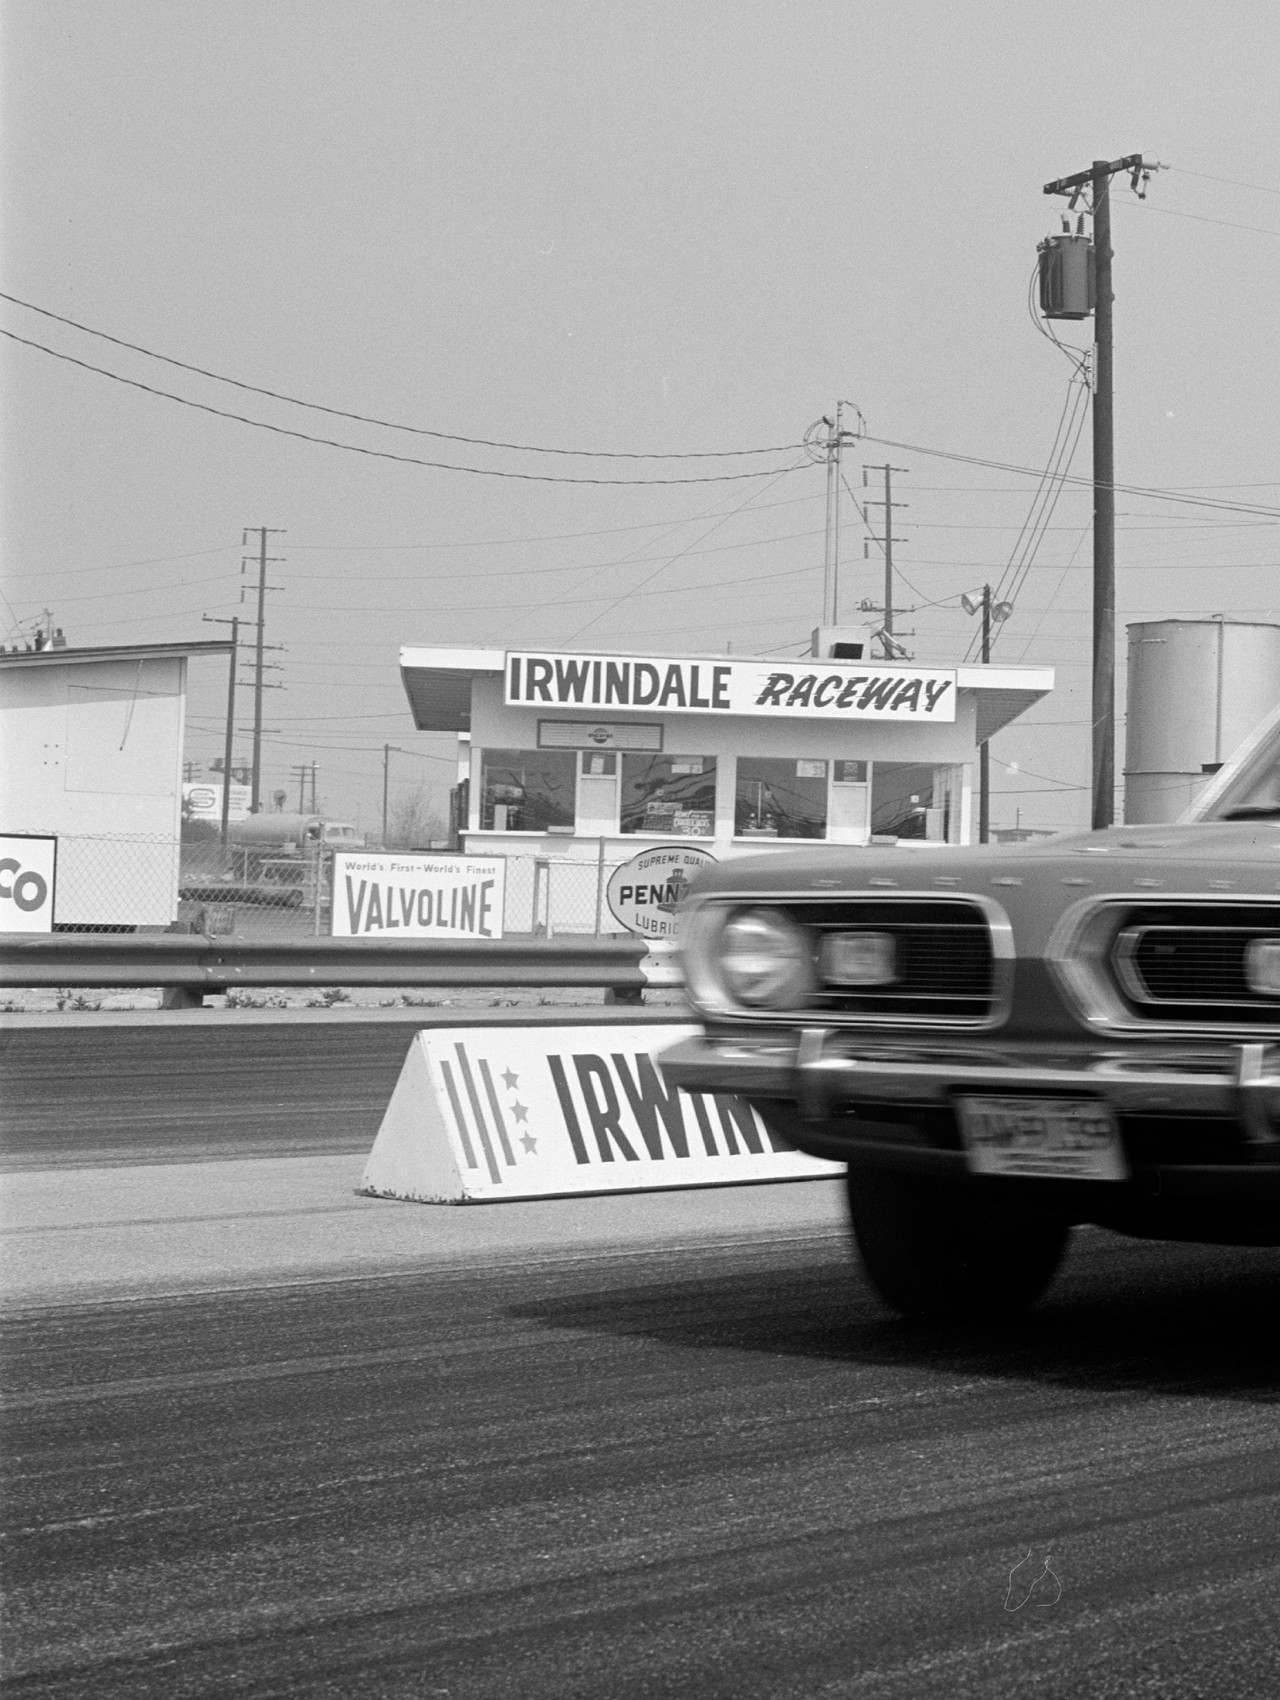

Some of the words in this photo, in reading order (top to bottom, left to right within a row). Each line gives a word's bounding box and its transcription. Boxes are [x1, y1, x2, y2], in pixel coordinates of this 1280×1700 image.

[509, 657, 732, 709] IRWINDALE
[752, 672, 953, 713] RACEWAY
[345, 861, 384, 872] World's
[466, 865, 496, 875] Finest
[638, 854, 680, 871] SUPREME
[345, 874, 495, 938] VALVOLINE
[546, 1052, 798, 1165] IRWIN
